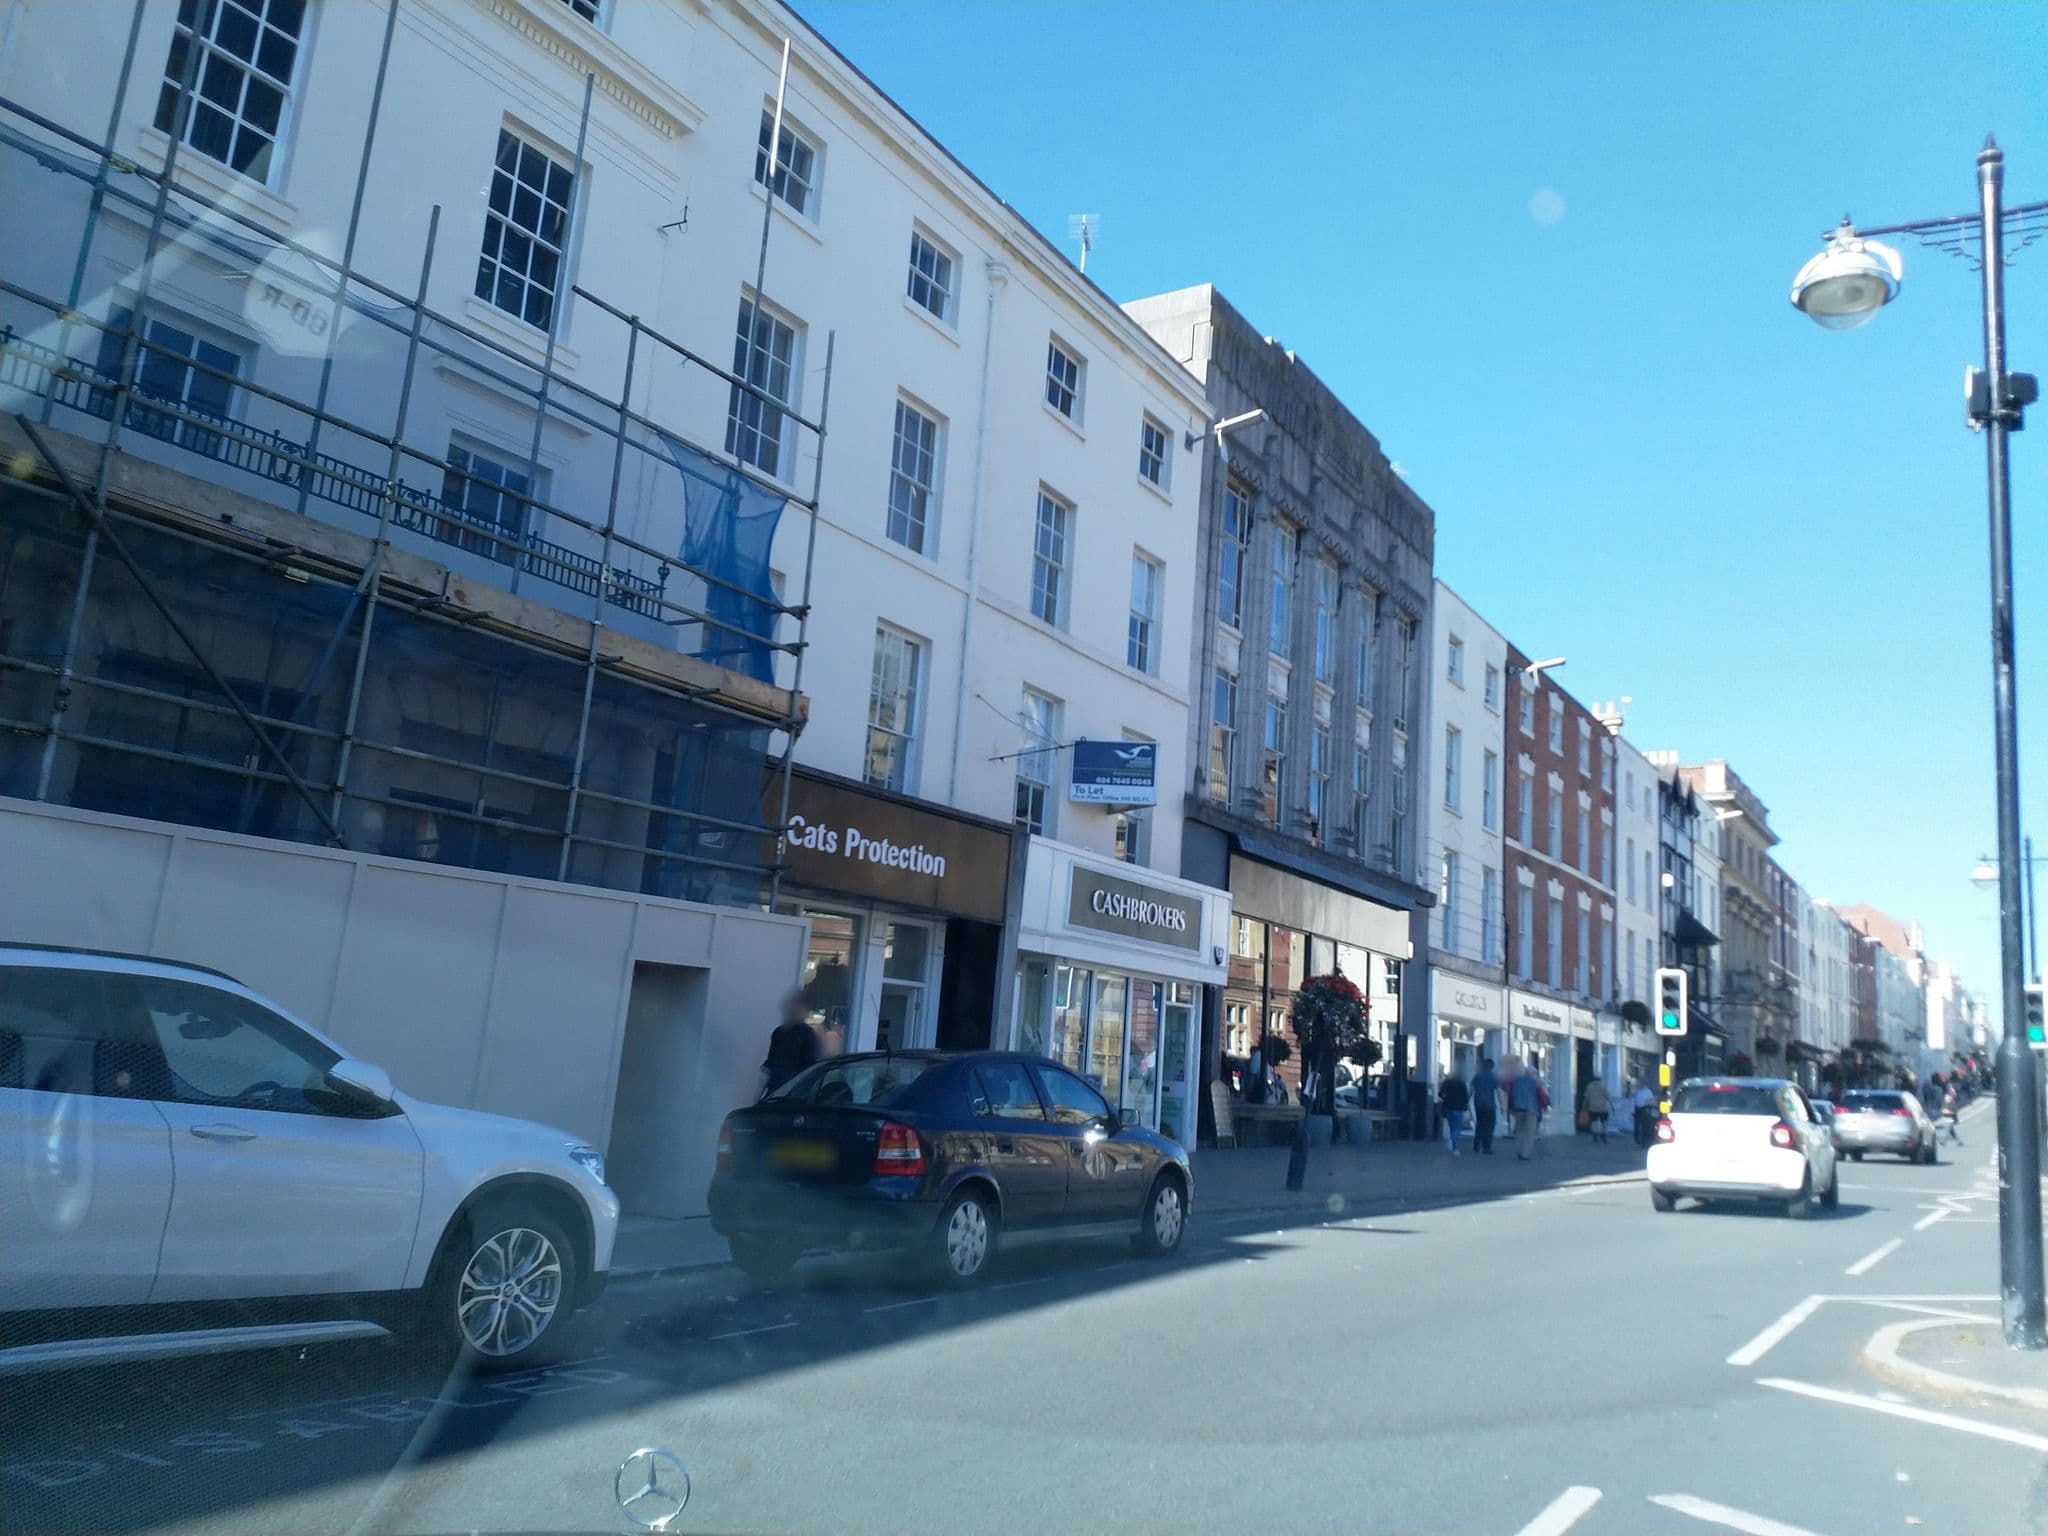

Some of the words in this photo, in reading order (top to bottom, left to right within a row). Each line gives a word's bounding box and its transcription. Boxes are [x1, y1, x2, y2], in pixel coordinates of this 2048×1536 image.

[1075, 785, 1086, 794] To
[1087, 786, 1104, 795] Let
[787, 815, 838, 853] Cats
[844, 828, 945, 878] Protection
[1092, 889, 1186, 931] CASHBROKERS
